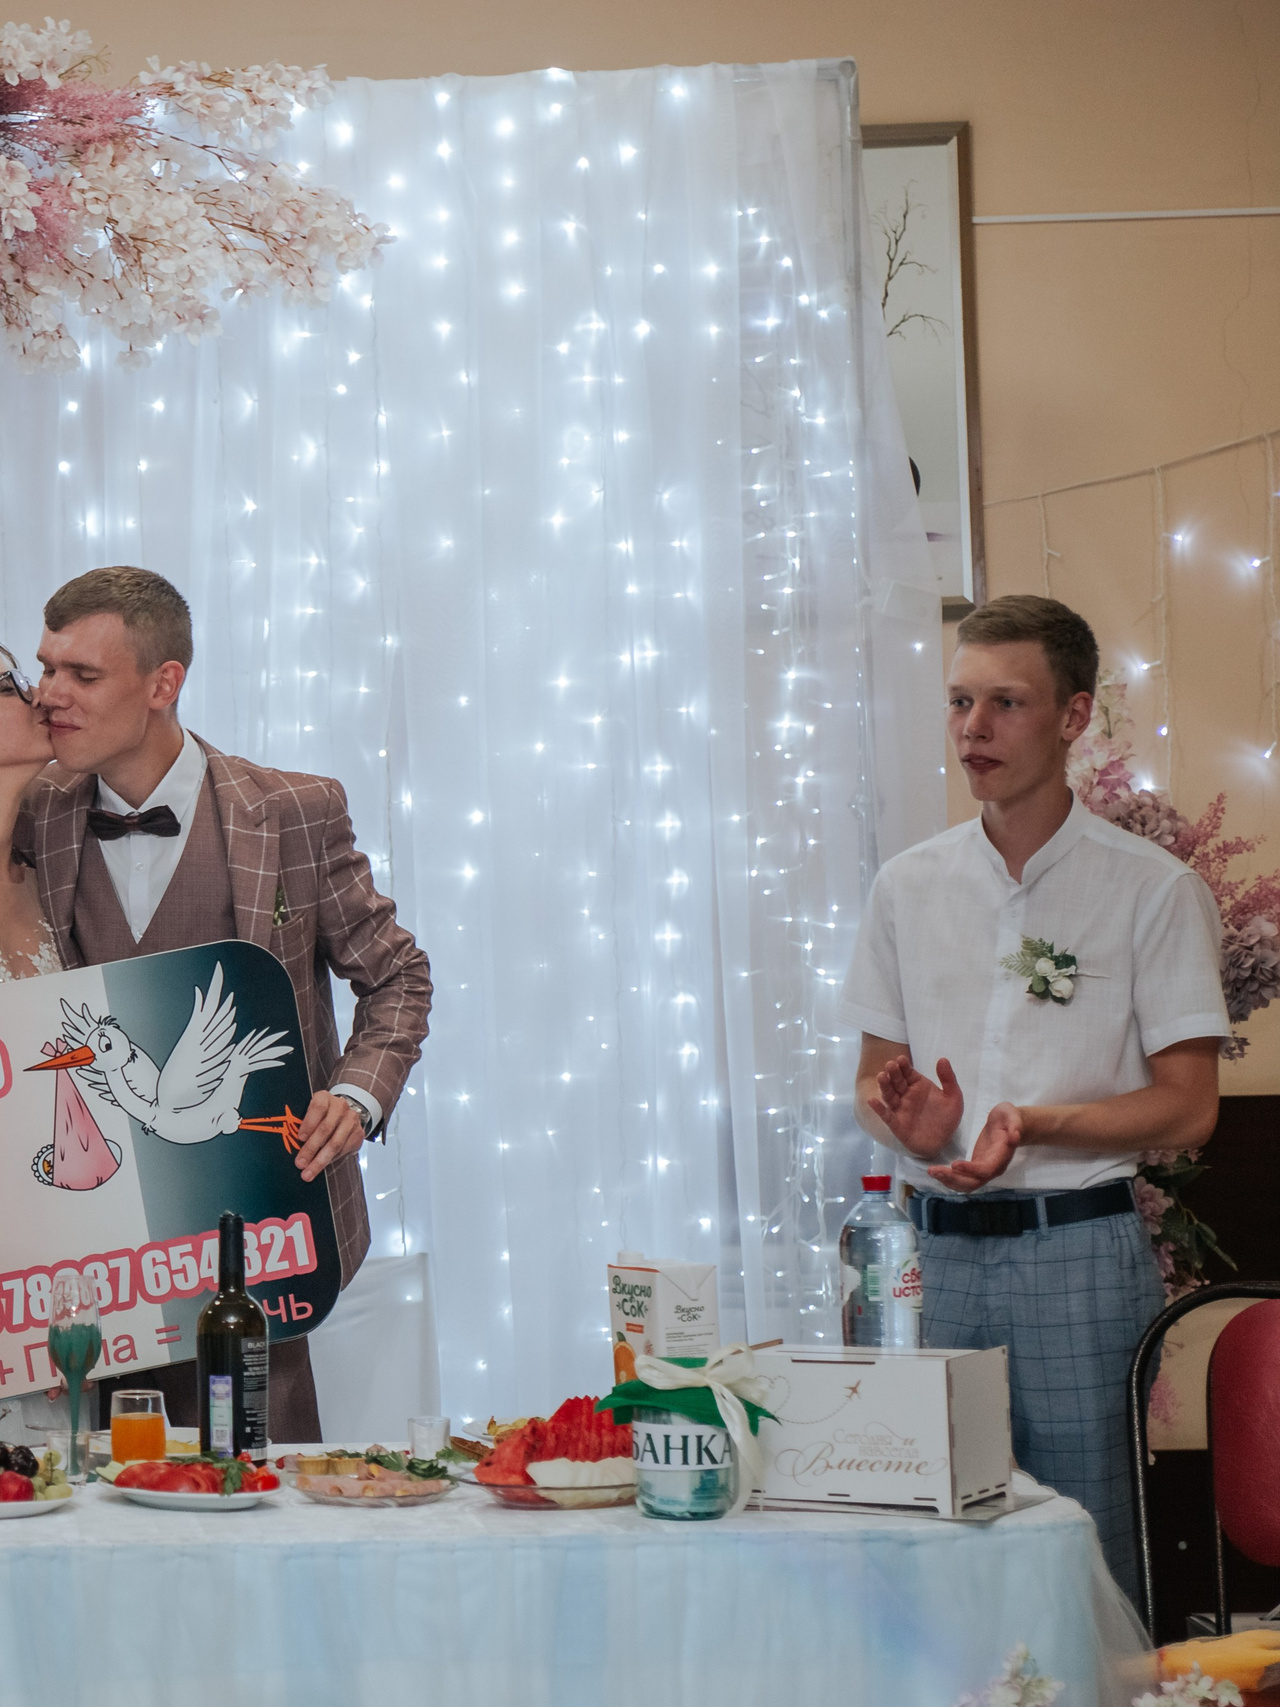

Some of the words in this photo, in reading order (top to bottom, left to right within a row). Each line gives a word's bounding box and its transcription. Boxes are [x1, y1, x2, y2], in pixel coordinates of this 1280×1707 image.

[140, 1237, 220, 1298] 654
[242, 1220, 311, 1279] 321
[612, 1275, 652, 1300] Вкусно
[674, 1305, 705, 1315] Вкусно
[23, 1333, 139, 1384] Па
[775, 1441, 948, 1487] Вместе
